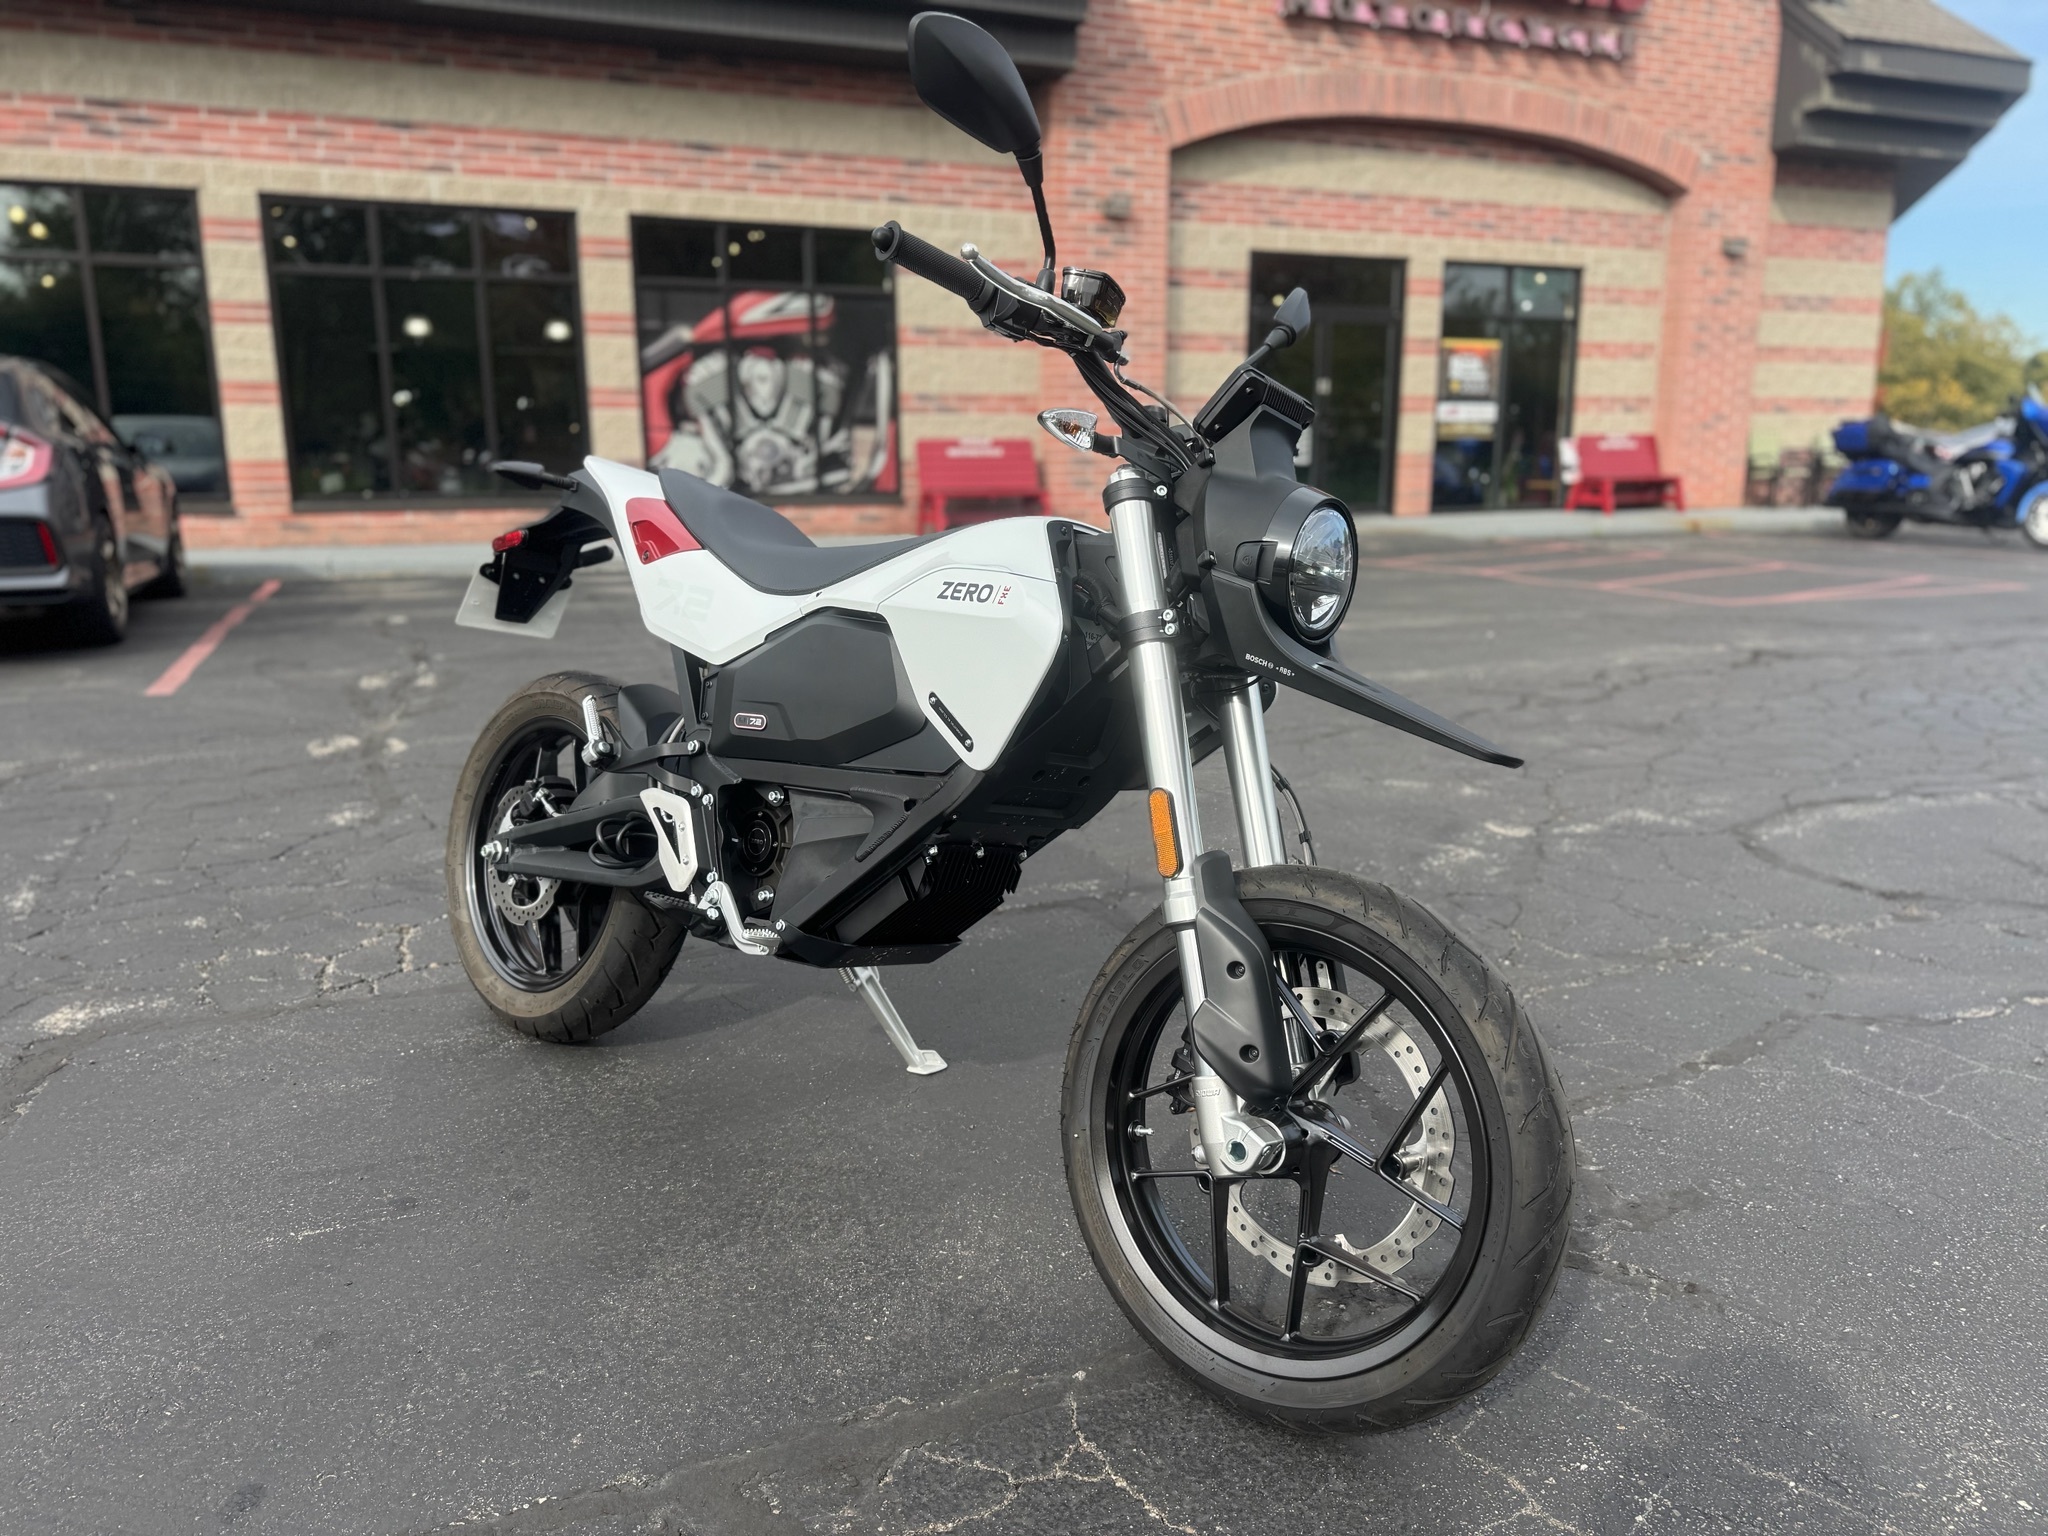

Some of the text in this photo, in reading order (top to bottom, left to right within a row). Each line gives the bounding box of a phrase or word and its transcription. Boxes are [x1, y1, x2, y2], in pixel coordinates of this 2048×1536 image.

[937, 581, 1012, 605] ZERO FXE
[1245, 653, 1291, 677] BOSCH ABS
[1095, 958, 1145, 1028] DIABLO
